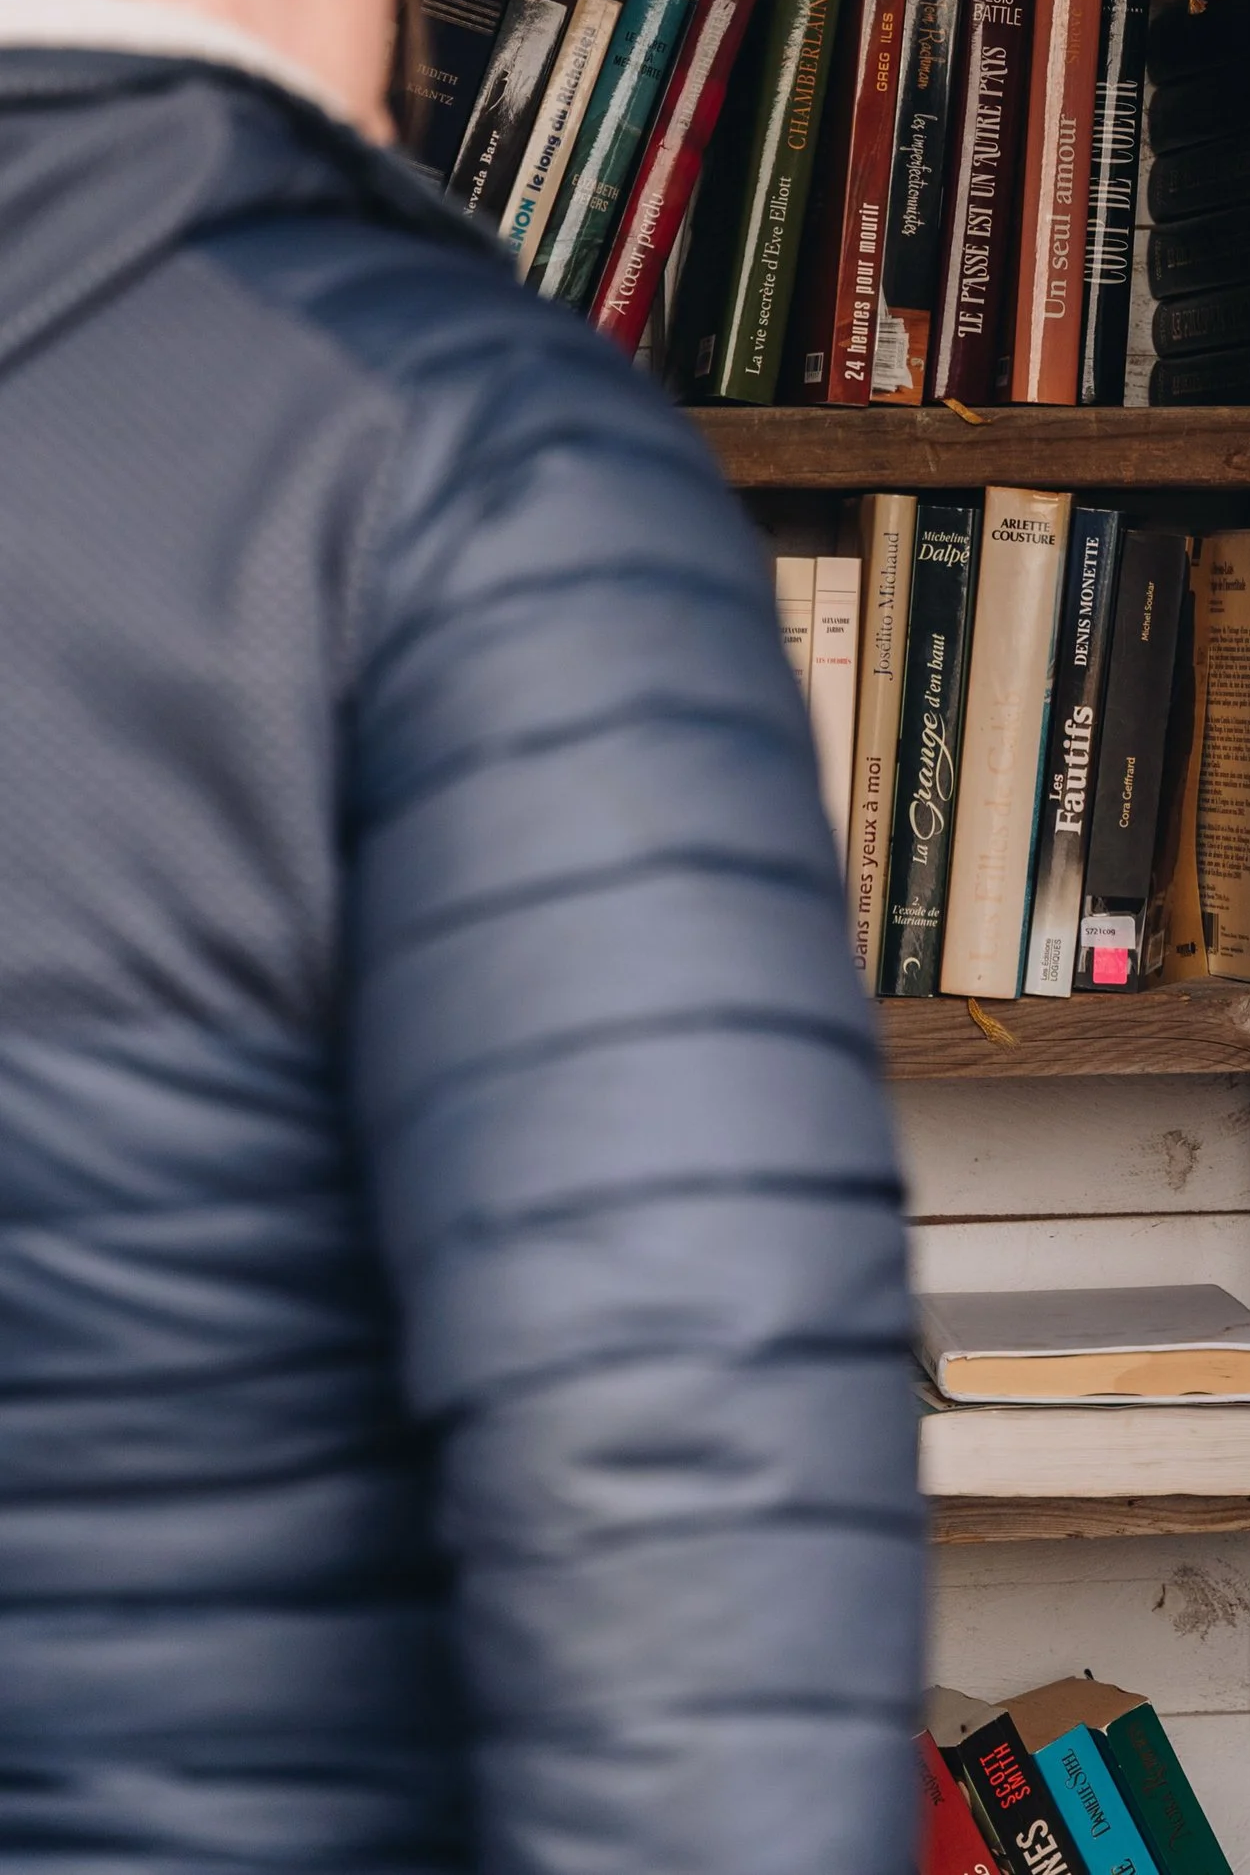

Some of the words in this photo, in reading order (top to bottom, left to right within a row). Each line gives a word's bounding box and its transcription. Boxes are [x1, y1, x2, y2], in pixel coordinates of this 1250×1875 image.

[880, 11, 894, 44] ILES
[972, 3, 1023, 27] BATTLE
[417, 62, 459, 86] JUDITH
[876, 52, 891, 93] GREG
[981, 46, 1007, 99] PAYS
[479, 128, 500, 166] Barr
[973, 98, 1002, 170] AUTRE
[1055, 113, 1078, 206] amour
[769, 175, 793, 223] Elliott
[971, 170, 996, 200] UN
[858, 202, 881, 251] mourir
[967, 202, 994, 239] EST
[761, 223, 783, 269] d'Eve
[1047, 213, 1072, 272] seul
[856, 251, 876, 295] pour
[960, 235, 990, 308] PASSÉ
[757, 270, 775, 325] secrète
[1044, 283, 1067, 322] Un
[754, 326, 768, 351] vie
[847, 300, 871, 355] heures
[957, 307, 984, 338] LE
[745, 352, 764, 376] La
[844, 358, 865, 383] 24
[922, 531, 970, 546] Micheline
[991, 530, 1056, 547] COUSTURE
[1000, 518, 1052, 532] ARLETTE
[878, 532, 901, 609] Michaud
[918, 543, 970, 568] Dalpé
[1078, 537, 1100, 615] MONETTE
[1143, 580, 1155, 610] Soukar
[820, 617, 851, 625] ALEXANDRE
[1140, 611, 1153, 642] Michel
[874, 616, 893, 680] Josélito
[1074, 618, 1092, 666] DENIS
[1049, 772, 1064, 802] Les
[1054, 705, 1094, 836] Fautifs
[1120, 756, 1136, 805] Geffrard
[1119, 806, 1132, 828] Cora
[892, 914, 939, 928] Marianne
[1050, 938, 1062, 982] LOGIQUES
[980, 1754, 1016, 1810] SCOTT
[994, 1743, 1031, 1808] SMITH
[1061, 1748, 1081, 1790] STEEL
[1082, 1787, 1111, 1840] DANIELLE
